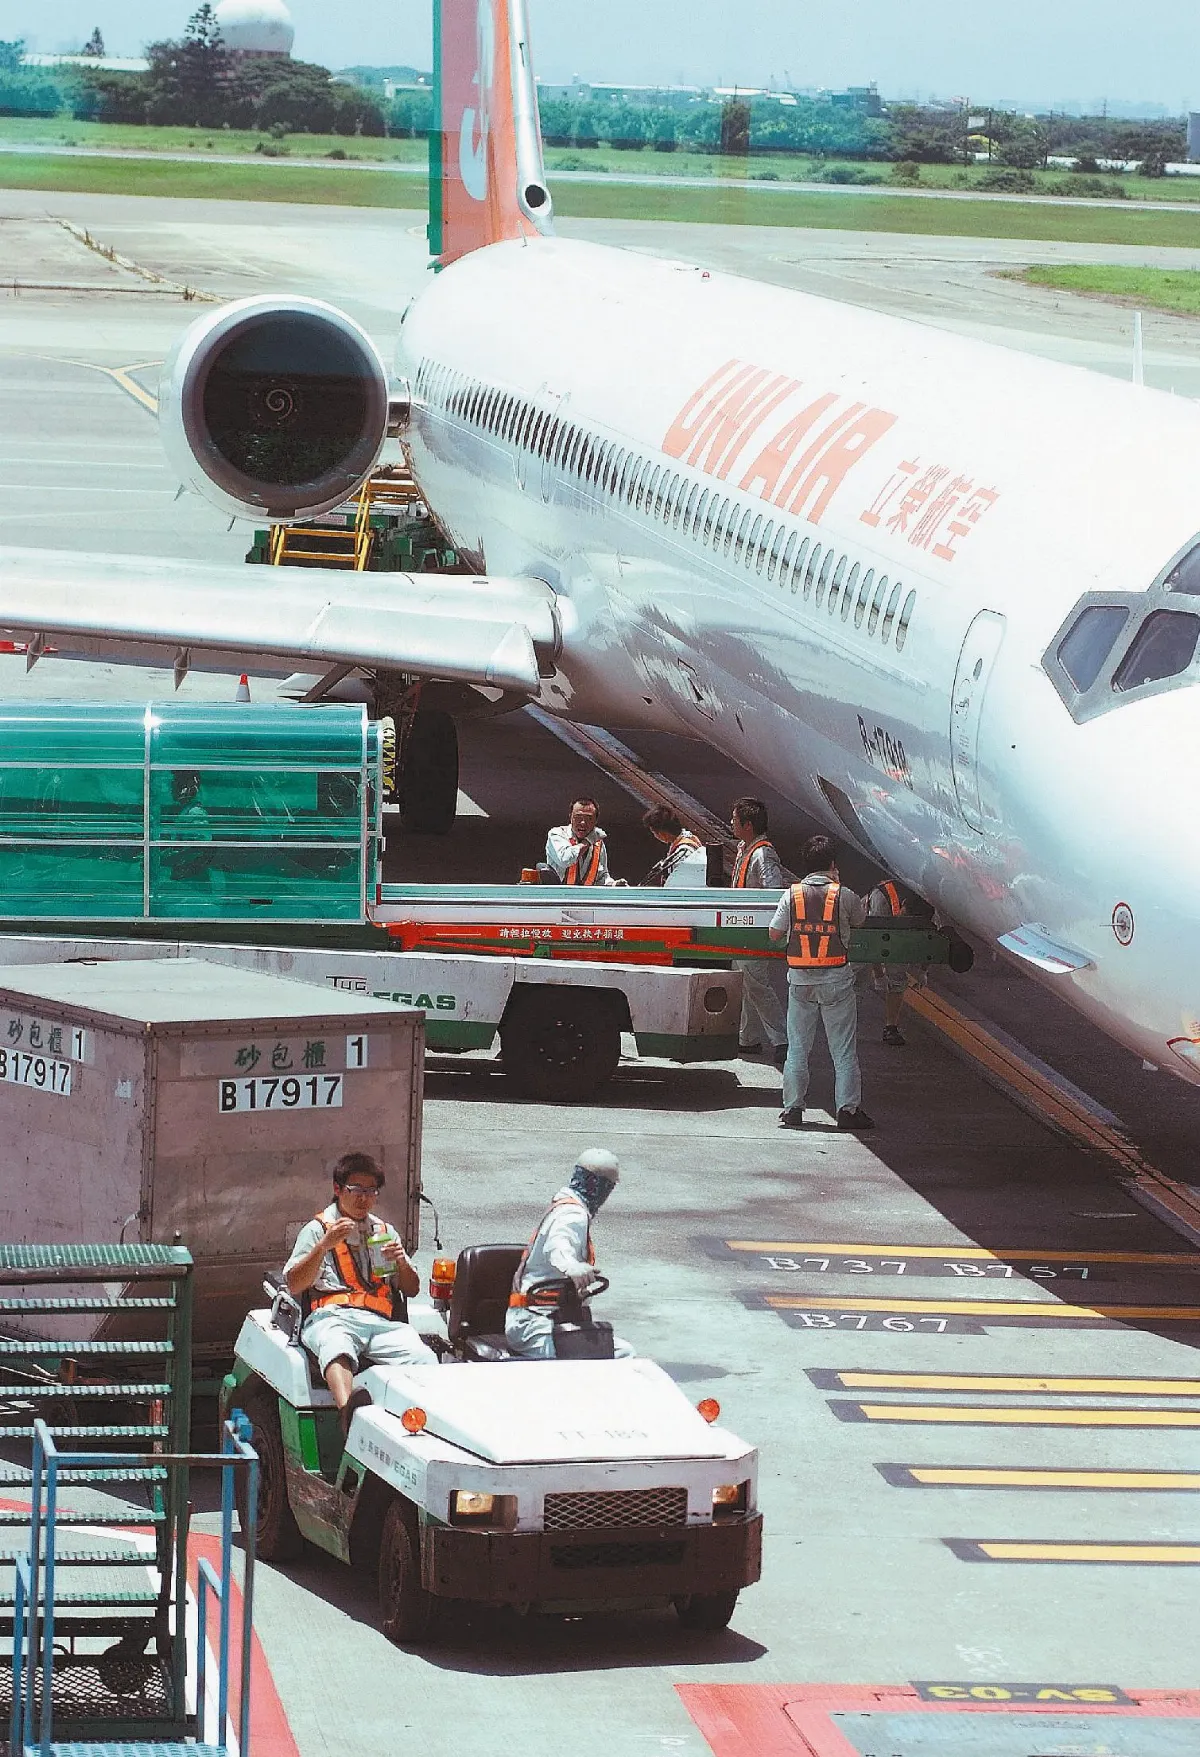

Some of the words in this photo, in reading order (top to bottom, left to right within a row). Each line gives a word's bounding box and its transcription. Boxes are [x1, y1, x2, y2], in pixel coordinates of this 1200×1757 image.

[661, 358, 803, 481] UNI
[738, 392, 899, 526] AIR
[75, 1030, 83, 1060] 1
[235, 1040, 327, 1074] 砂包櫃
[351, 1036, 364, 1067] 1
[221, 1076, 341, 1112] B17917
[760, 1256, 907, 1276] B737
[944, 1262, 1090, 1280] B757
[793, 1311, 949, 1332] B767
